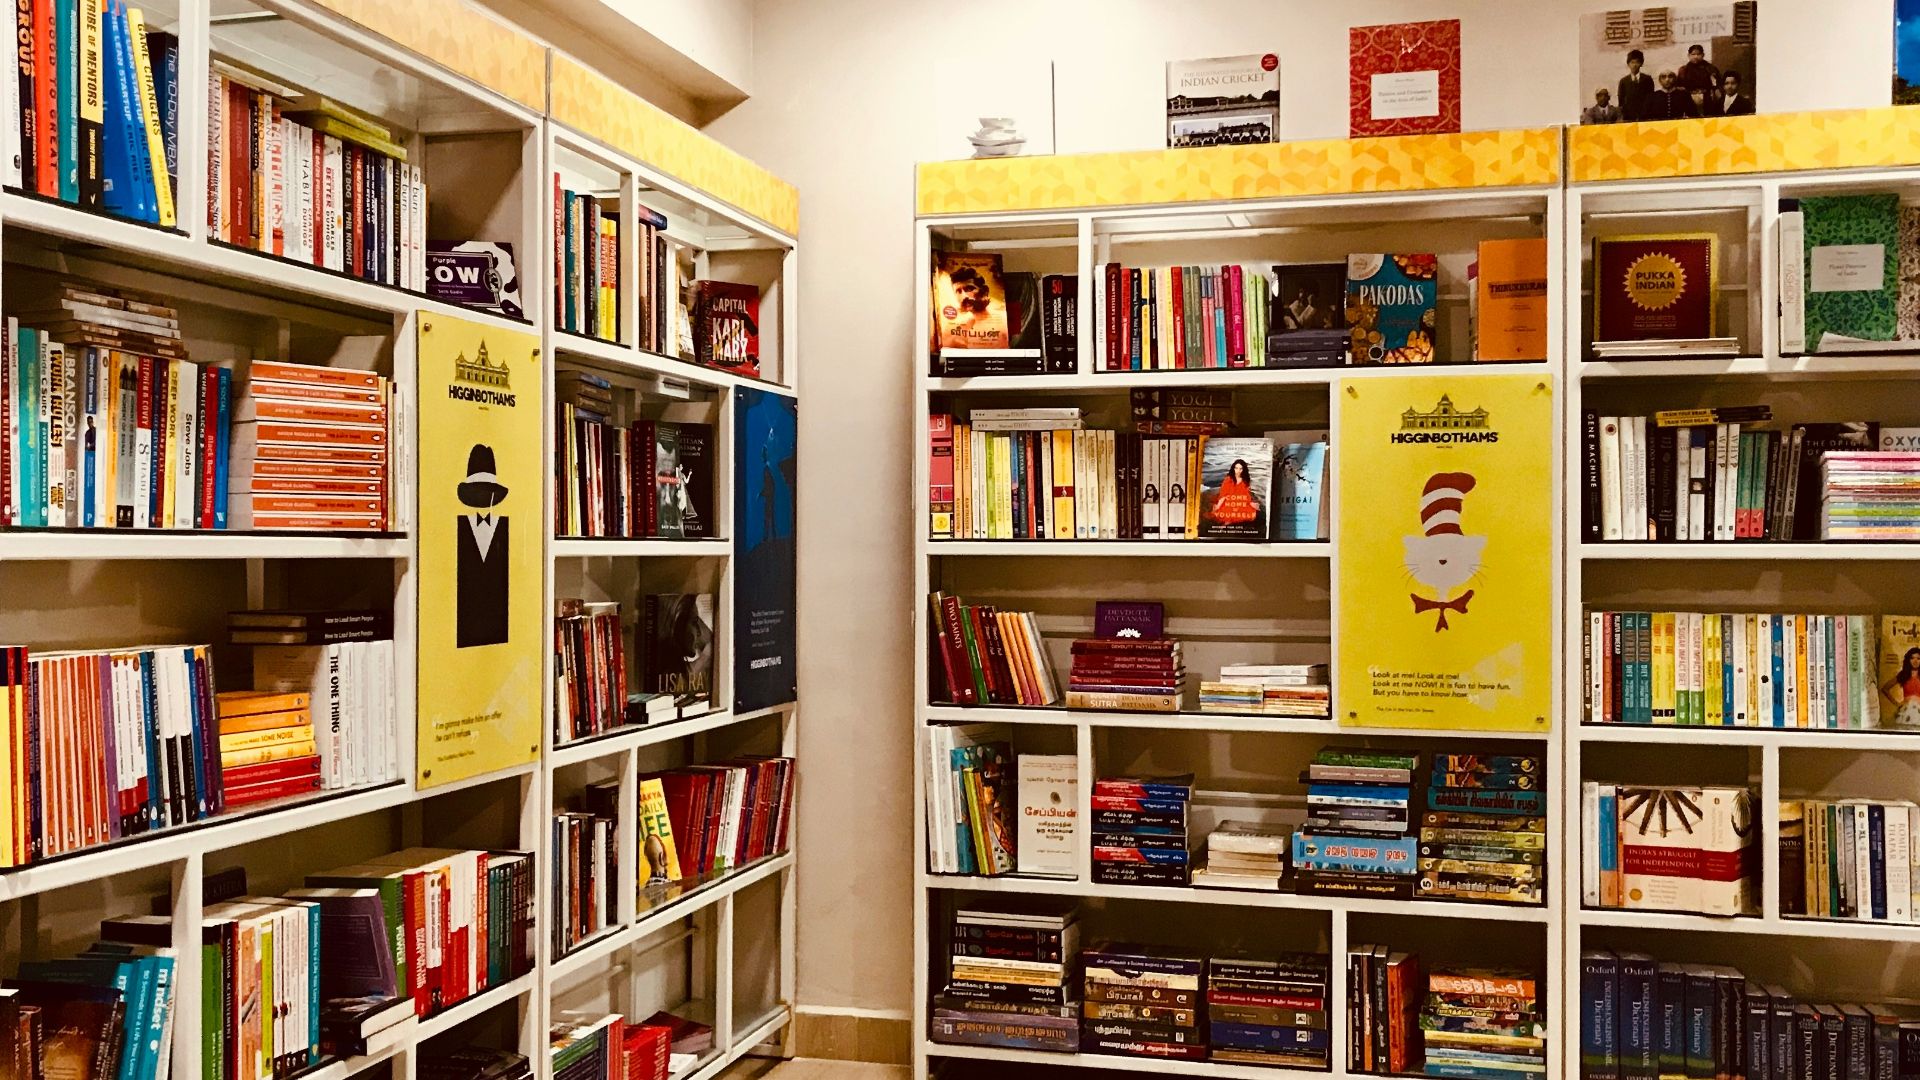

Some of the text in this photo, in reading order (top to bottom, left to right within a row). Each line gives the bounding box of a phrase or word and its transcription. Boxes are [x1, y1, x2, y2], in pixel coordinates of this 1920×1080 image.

[1680, 20, 1727, 36] THEN
[86, 48, 97, 107] MENTORS
[114, 35, 132, 120] LEAN STARTUP
[126, 39, 144, 124] LEAN STARTUP
[137, 24, 160, 136] GAME CHANGERS
[1181, 74, 1265, 87] INDIAN CRICKET
[48, 16, 58, 170] GOOD TO GREAT
[166, 46, 178, 169] The 10-Day MBA
[126, 124, 135, 150] ERIC
[425, 266, 480, 284] OW
[1052, 280, 1062, 294] 50
[1636, 281, 1675, 289] INDIAN
[712, 296, 748, 314] CAPITAL
[1360, 285, 1424, 306] PAKODAS
[712, 317, 746, 340] KARL
[950, 327, 1001, 338] வீரப்பன்
[712, 338, 748, 362] MARX
[42, 378, 47, 386] C
[51, 350, 62, 447] WORK RULES!
[66, 358, 75, 440] BRANSON
[448, 384, 516, 408] HIGGINBOTHAMS
[1172, 393, 1213, 406] YOGI
[1172, 408, 1213, 420] YOGI
[139, 443, 150, 454] 8
[1391, 432, 1498, 444] HIGGINBOTHAMS
[1730, 434, 1739, 468] WHY?
[205, 476, 213, 513] Thinking
[948, 602, 962, 649] TWO SAINTS
[330, 655, 339, 733] THE ONE THING
[658, 671, 709, 694] LISA RAY
[640, 802, 663, 816] DAILY
[1642, 859, 1700, 868] INDEPENDENCE
[1659, 850, 1697, 858] STRUGGLE
[396, 925, 405, 965] POWER
[1586, 966, 1616, 974] Oxford
[138, 981, 148, 1010] Seconds
[150, 968, 168, 1030] mindset
[1594, 1000, 1603, 1046] Dictionary
[1632, 1002, 1641, 1047] Dictionary
[1665, 1004, 1673, 1049] Dictionary
[1694, 1008, 1703, 1054] Dictionary
[1777, 1034, 1786, 1073] Dictionary
[128, 1058, 136, 1076] Love
